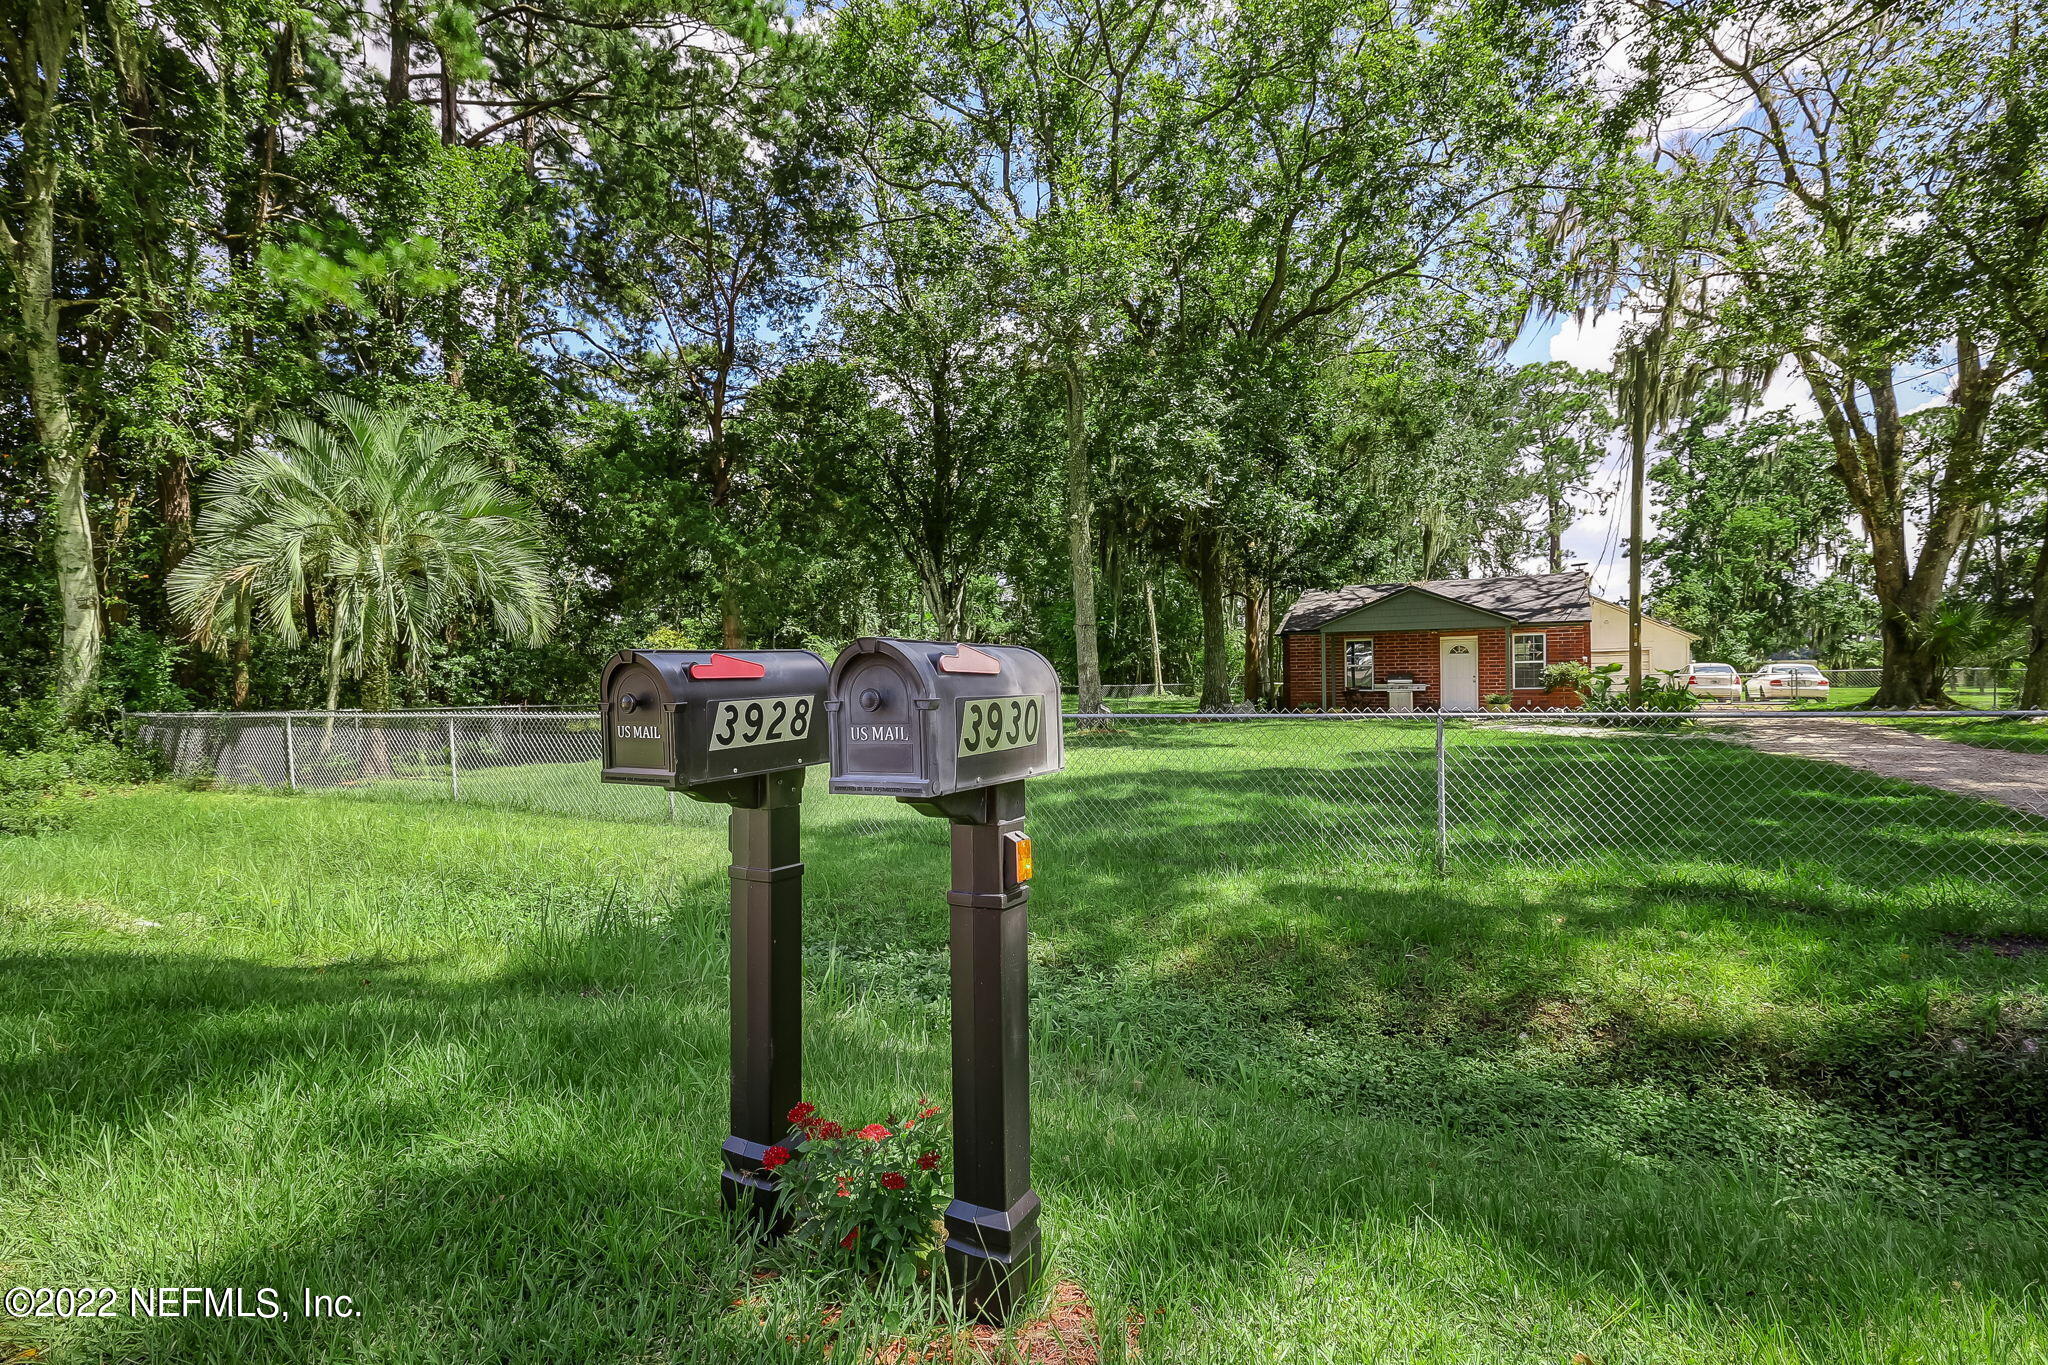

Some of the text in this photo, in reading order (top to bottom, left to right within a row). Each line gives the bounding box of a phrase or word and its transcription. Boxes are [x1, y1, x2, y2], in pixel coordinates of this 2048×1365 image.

[617, 725, 661, 739] US MAIL
[716, 698, 810, 746] 3928
[850, 726, 909, 741] US MAIL
[963, 698, 1039, 752] 3930
